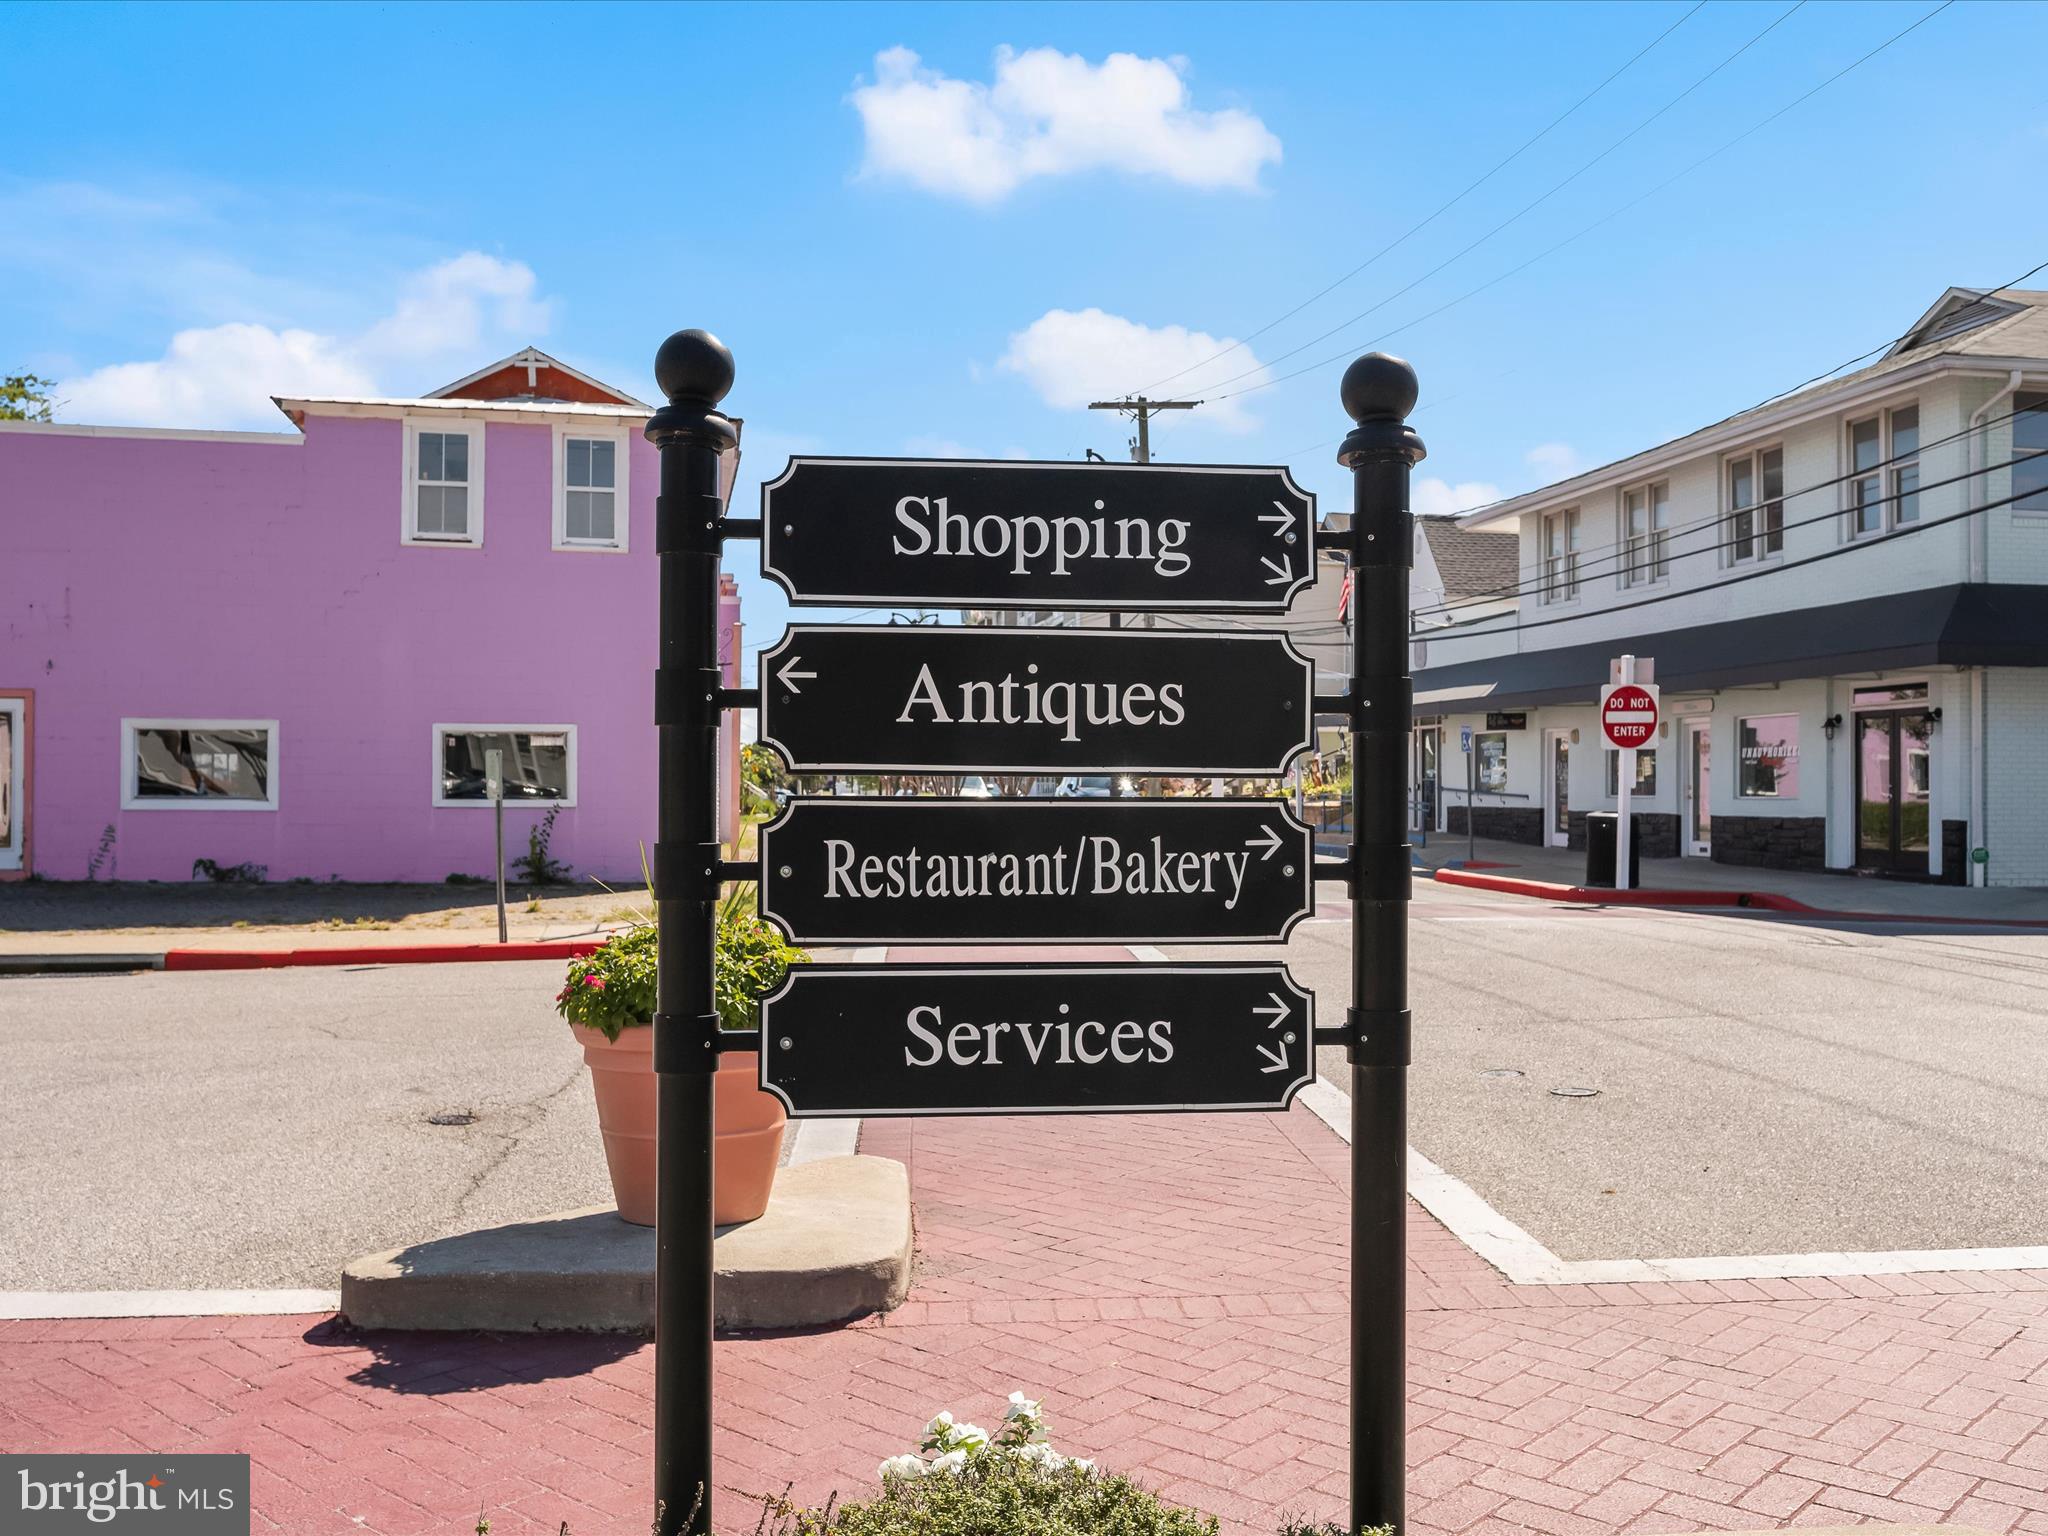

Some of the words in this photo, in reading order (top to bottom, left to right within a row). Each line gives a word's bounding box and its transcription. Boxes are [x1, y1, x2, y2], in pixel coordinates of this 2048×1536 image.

[893, 496, 1191, 577] Shopping
[896, 664, 1185, 742] Antiques
[1610, 698, 1624, 709] DO
[1630, 698, 1650, 708] NOT
[1613, 726, 1646, 737] ENTER
[823, 836, 1250, 910] Restaurant/Bakery
[905, 1004, 1174, 1066] Services
